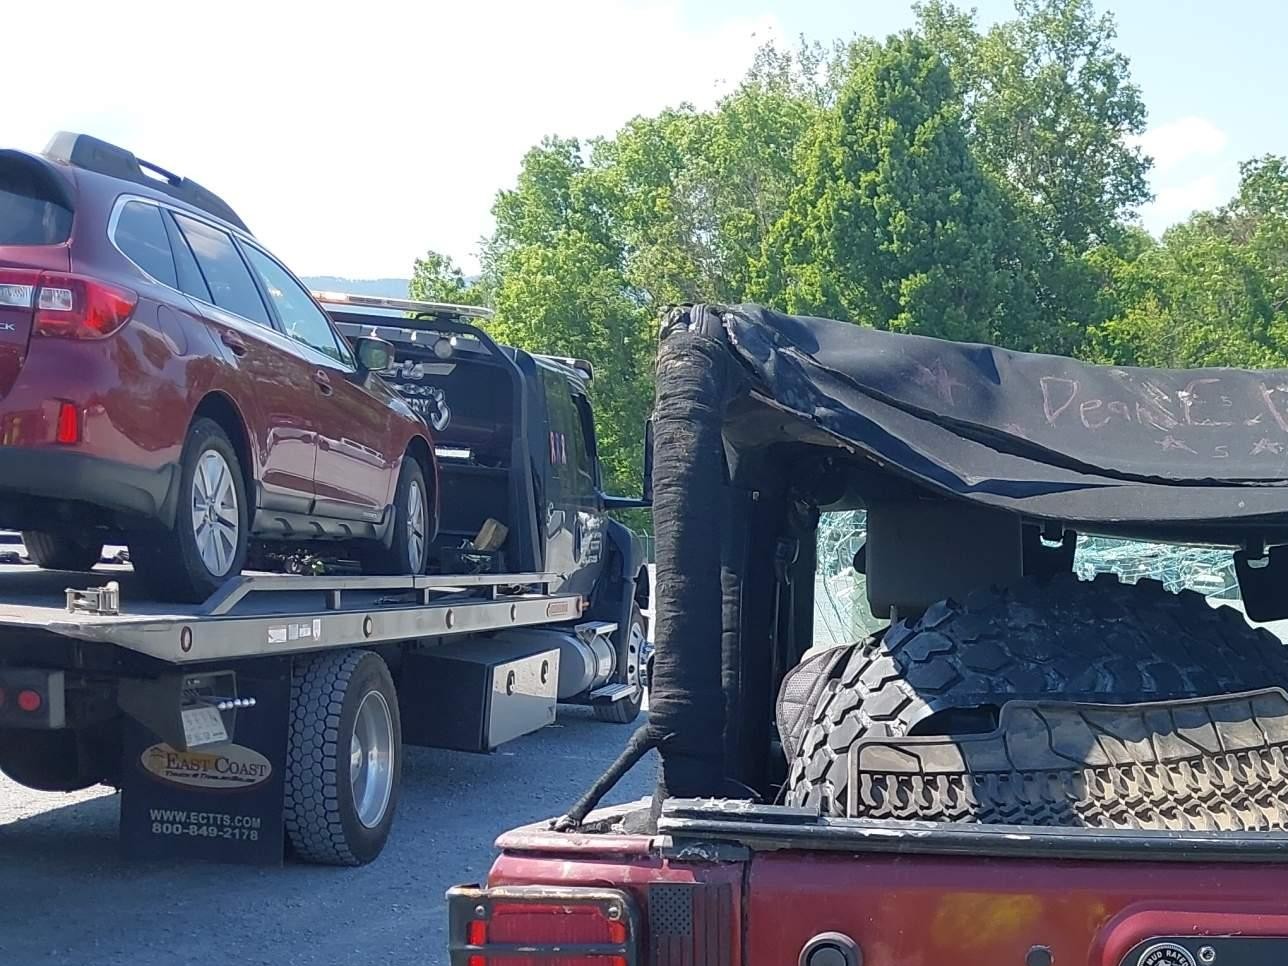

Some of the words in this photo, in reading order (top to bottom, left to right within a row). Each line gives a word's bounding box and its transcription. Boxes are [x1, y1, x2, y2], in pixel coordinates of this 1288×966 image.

[165, 753, 212, 772] EAST
[214, 757, 267, 777] COAST
[149, 809, 261, 828] WWW.ECTTS.COM
[151, 823, 259, 841] 800-849-2178
[1146, 951, 1163, 966] MUD
